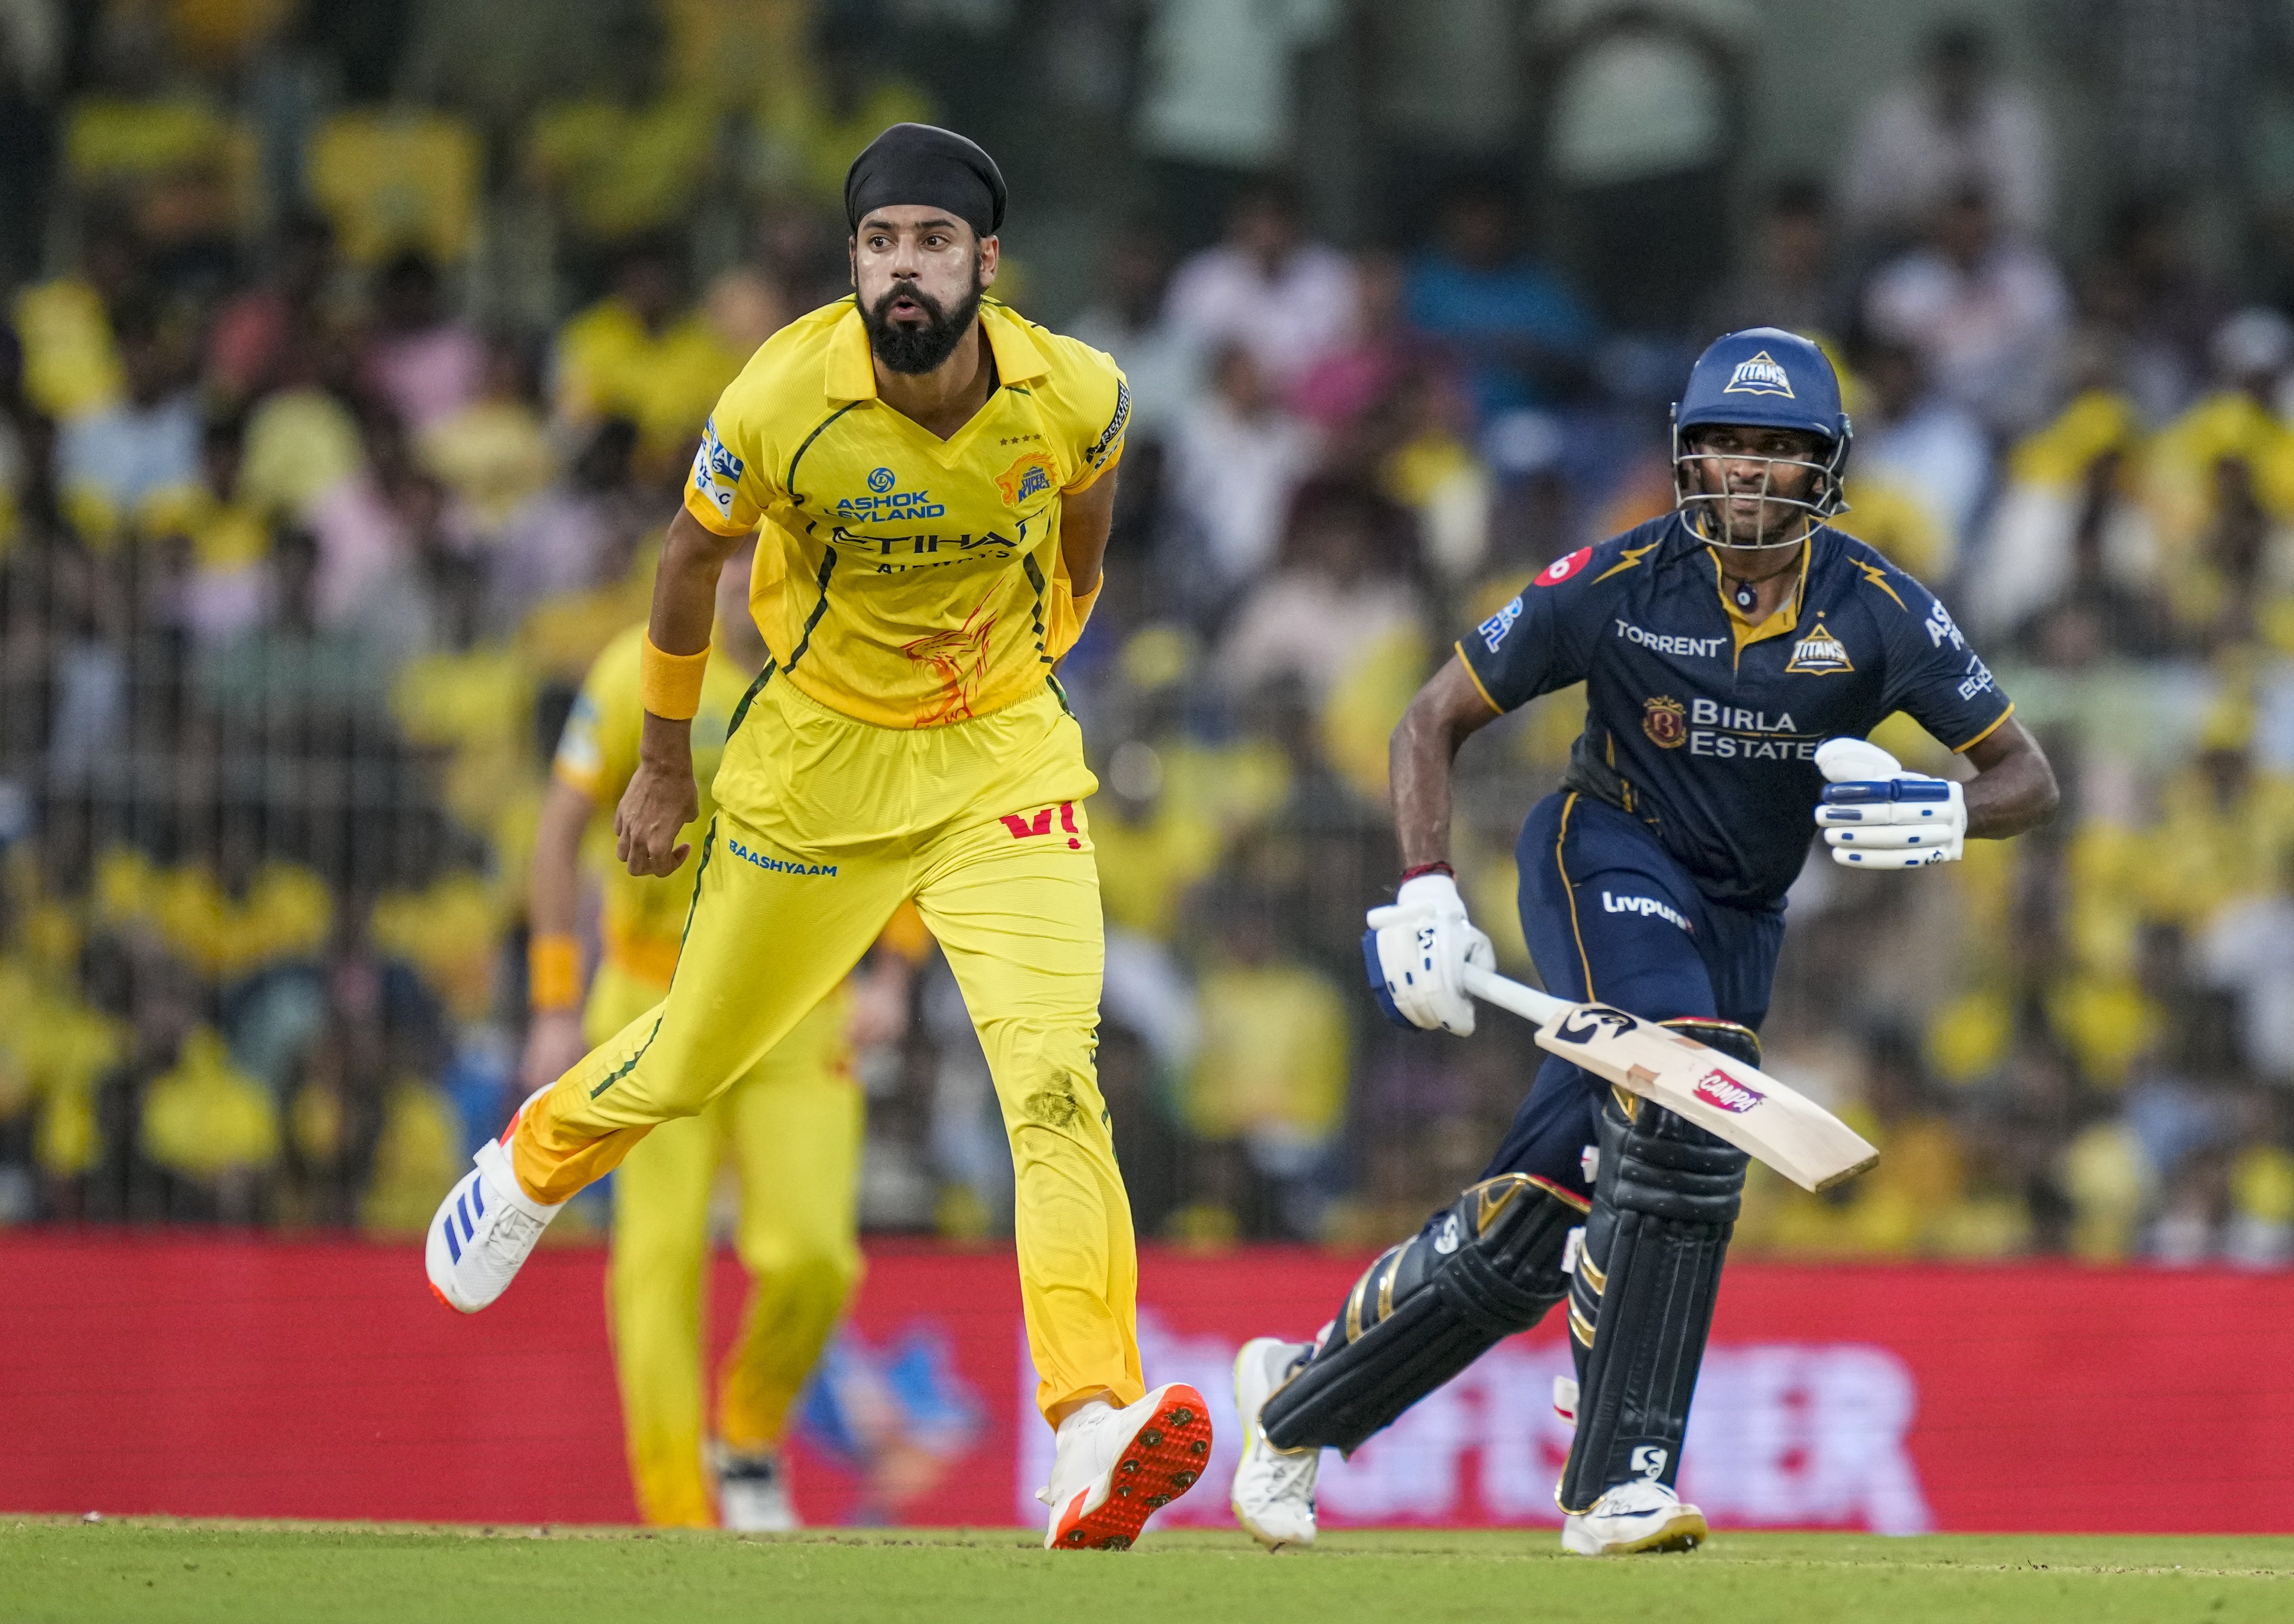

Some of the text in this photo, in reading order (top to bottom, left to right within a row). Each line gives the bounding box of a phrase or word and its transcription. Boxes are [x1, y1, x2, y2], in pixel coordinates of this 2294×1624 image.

[836, 490, 931, 510] ASHOK
[1615, 618, 1728, 658] TORRENT
[1793, 639, 1849, 663] TITANS
[1691, 698, 1797, 732] BIRLA
[1690, 731, 1825, 761] ESTATE
[729, 839, 837, 877] BAASHYAAM
[1700, 1075, 1757, 1112] CAMPA
